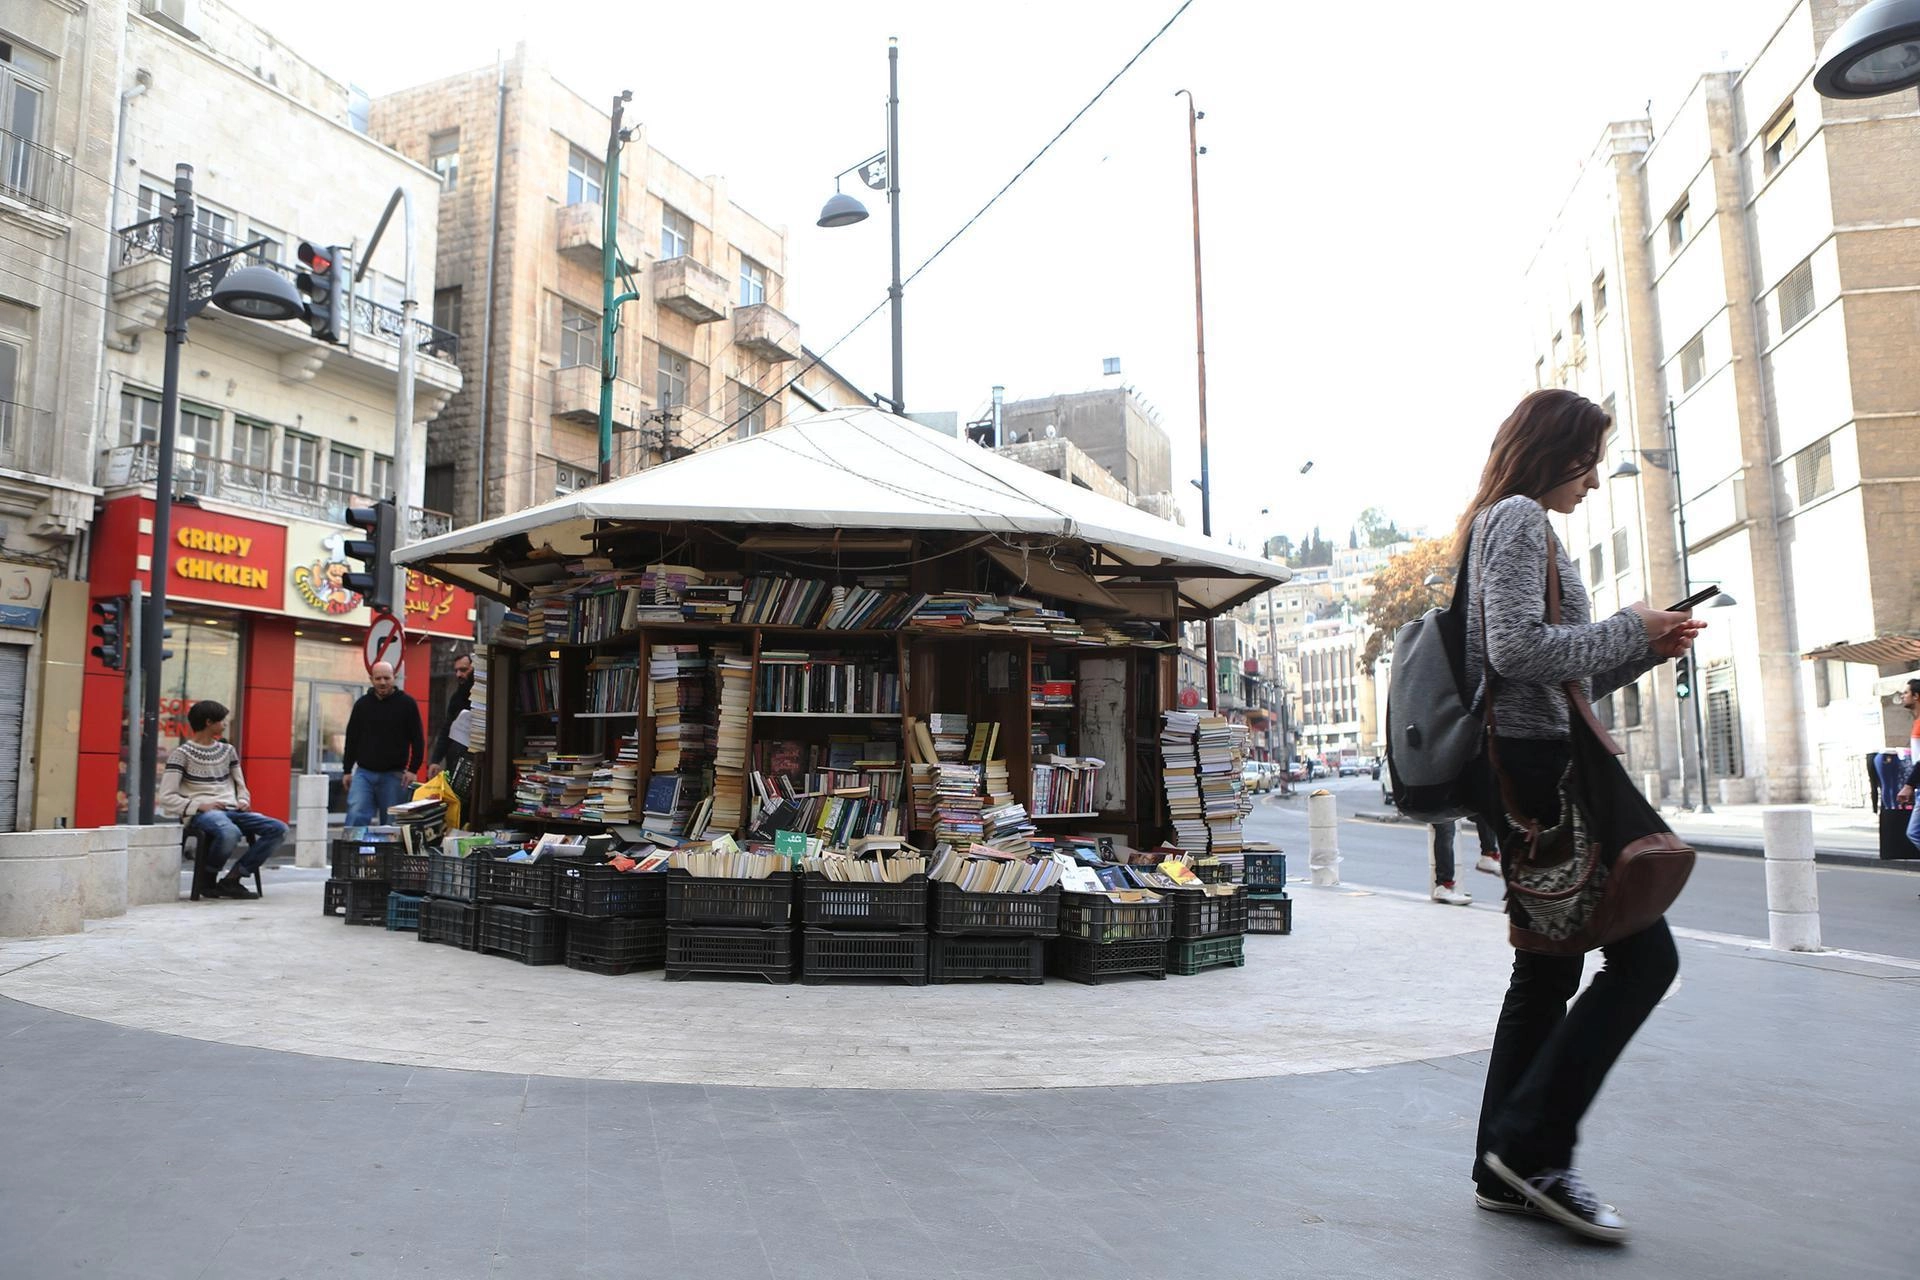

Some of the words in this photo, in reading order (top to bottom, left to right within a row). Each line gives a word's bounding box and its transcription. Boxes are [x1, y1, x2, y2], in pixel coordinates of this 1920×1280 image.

[177, 526, 252, 557] CRISPY
[176, 556, 269, 589] CHICKEN
[294, 566, 330, 612] CRISPY
